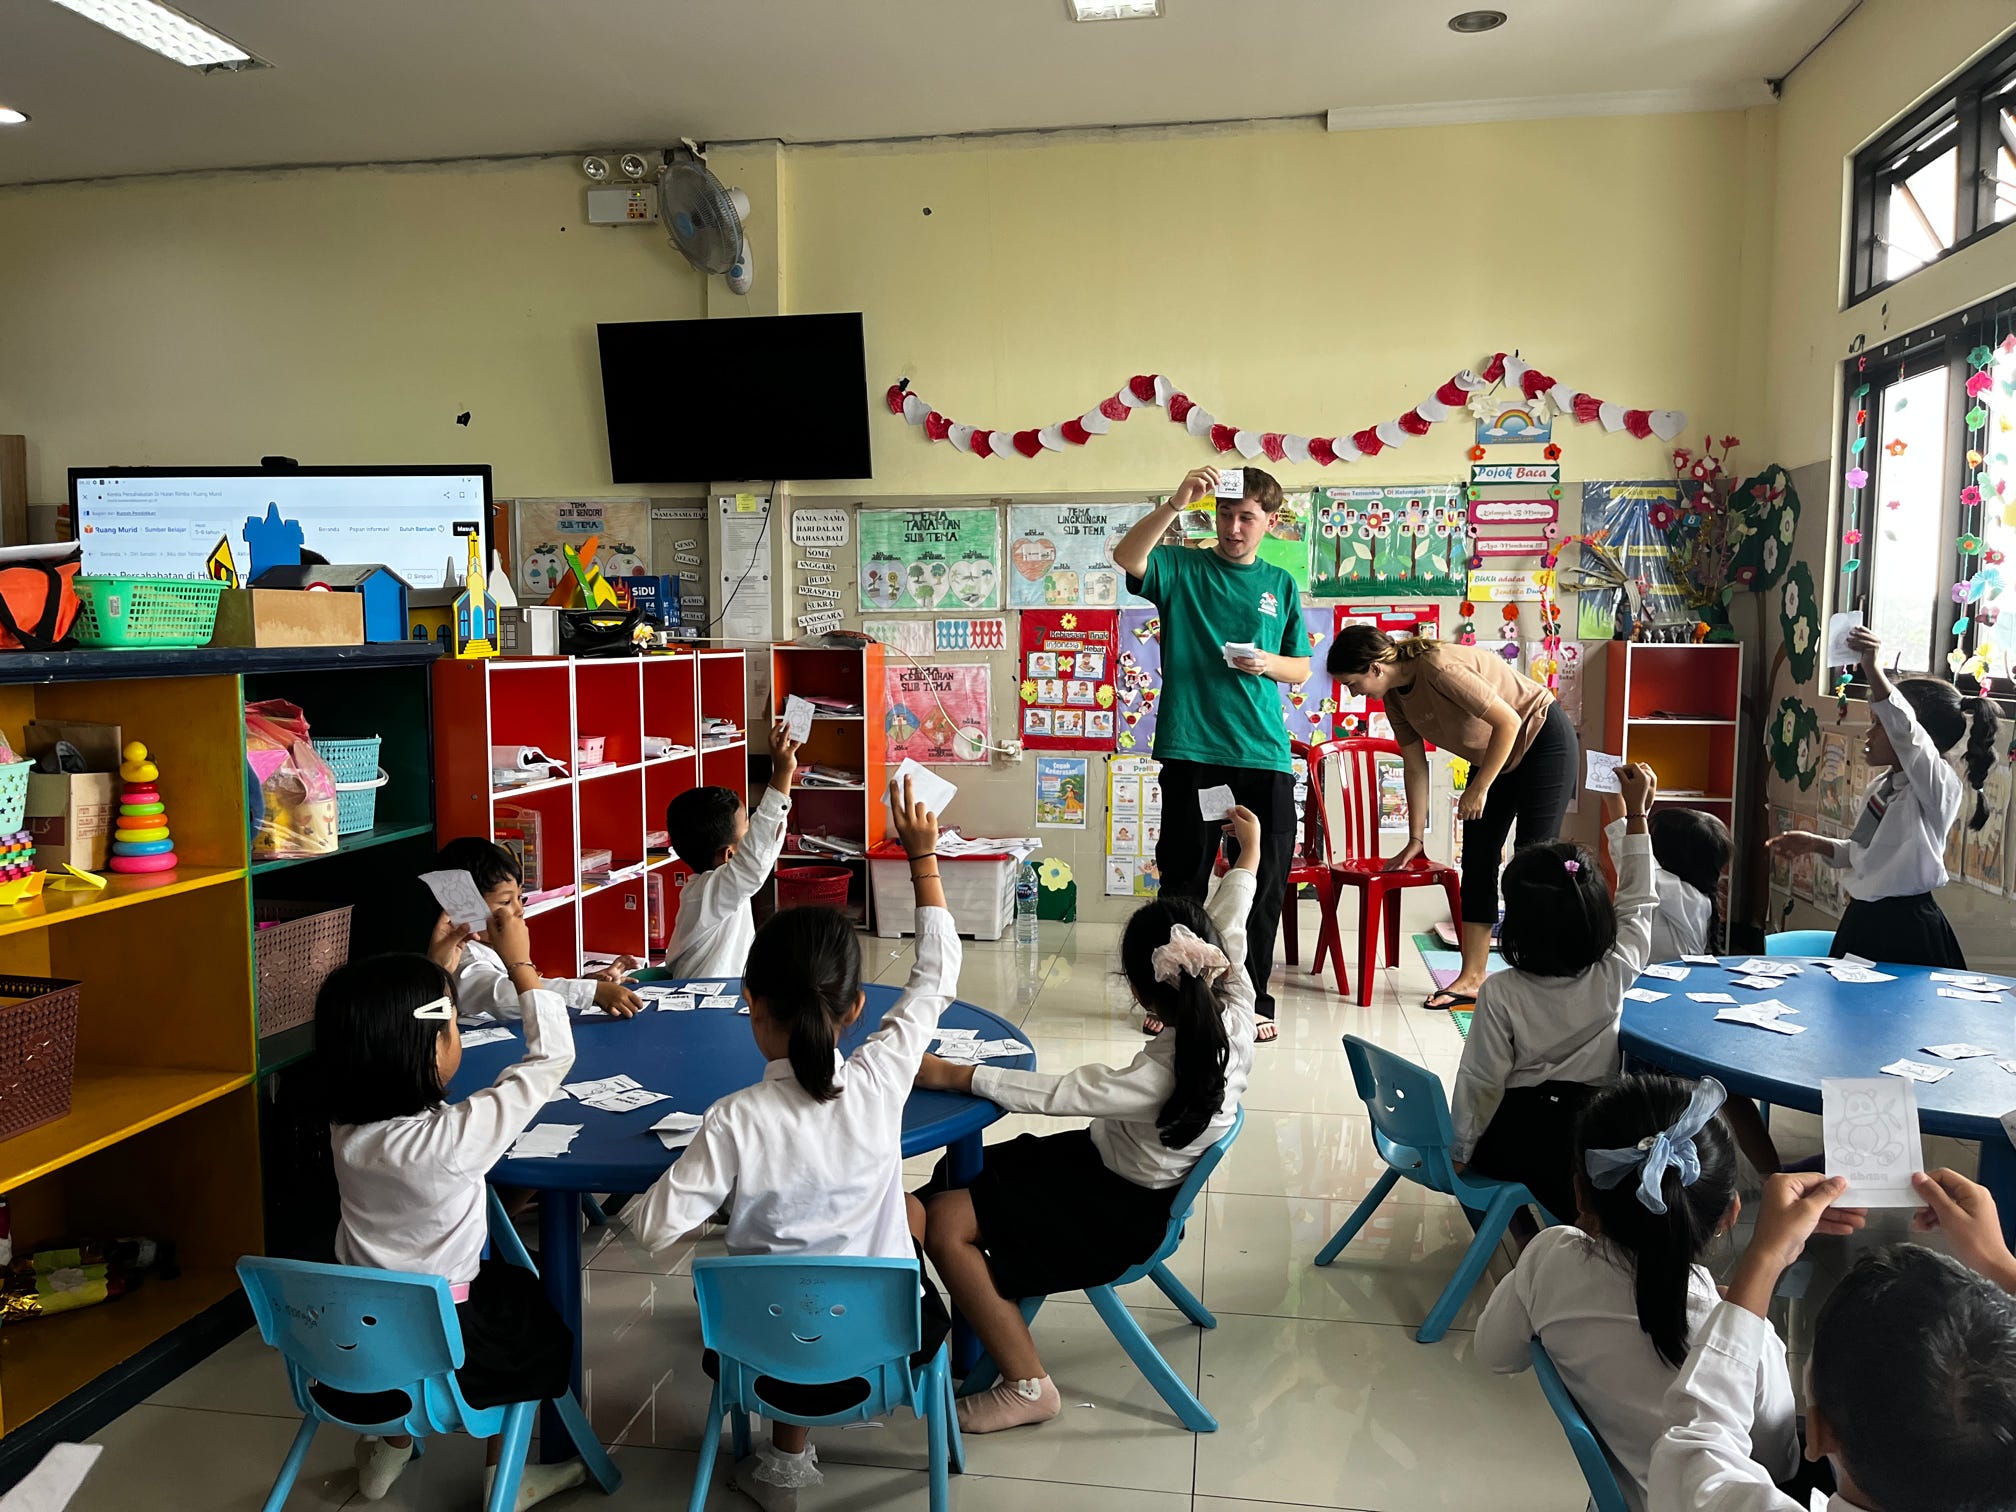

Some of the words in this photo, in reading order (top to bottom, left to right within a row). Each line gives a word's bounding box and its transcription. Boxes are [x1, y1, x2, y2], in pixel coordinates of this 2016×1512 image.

[1478, 467, 1512, 479] Pojok
[1516, 467, 1547, 478] Baca
[576, 508, 602, 517] SENDIRI
[906, 511, 948, 520] TEMA
[1067, 508, 1090, 516] TEMA
[576, 521, 599, 529] TEMA
[903, 519, 960, 531] TANAMAN
[1063, 526, 1080, 535] SUB
[1082, 526, 1105, 535] TEMA
[904, 533, 924, 542] SUB
[925, 532, 958, 542] TEMA
[807, 549, 830, 558] SOMA
[799, 561, 836, 571] ANGGARA
[809, 575, 831, 584] BUDA
[632, 586, 655, 596] SiDU
[800, 586, 840, 598] WRASPATI
[807, 600, 834, 608] SUKRA
[799, 611, 842, 624] SANISCARA
[1034, 626, 1046, 645] 7
[1050, 630, 1087, 639] Kebiasaan
[1089, 631, 1109, 640] Anak
[1084, 645, 1105, 653] Hebat
[901, 683, 920, 692] SUB
